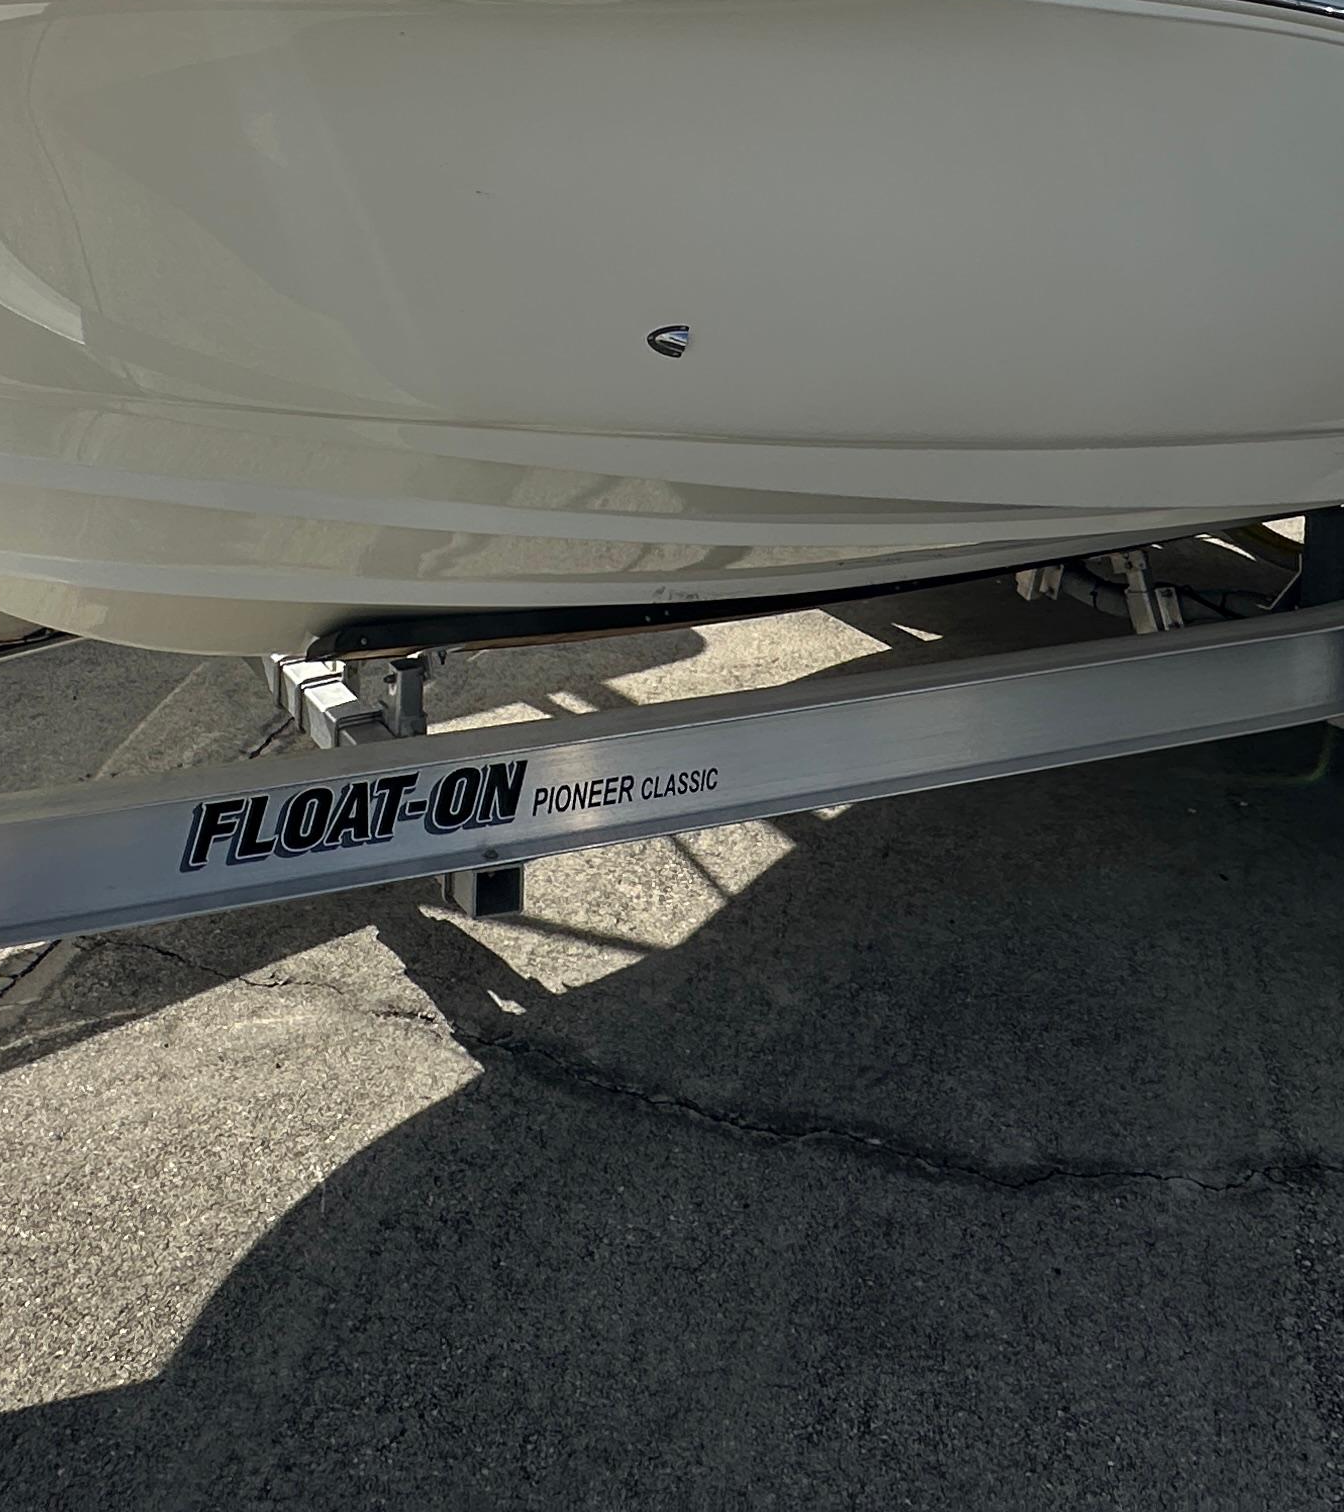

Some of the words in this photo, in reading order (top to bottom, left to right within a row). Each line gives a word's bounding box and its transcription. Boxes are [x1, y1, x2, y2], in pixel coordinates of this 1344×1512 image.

[179, 759, 529, 873] FLOAT-ON
[532, 774, 635, 817] PIONEER
[641, 767, 719, 801] CLASSIC
